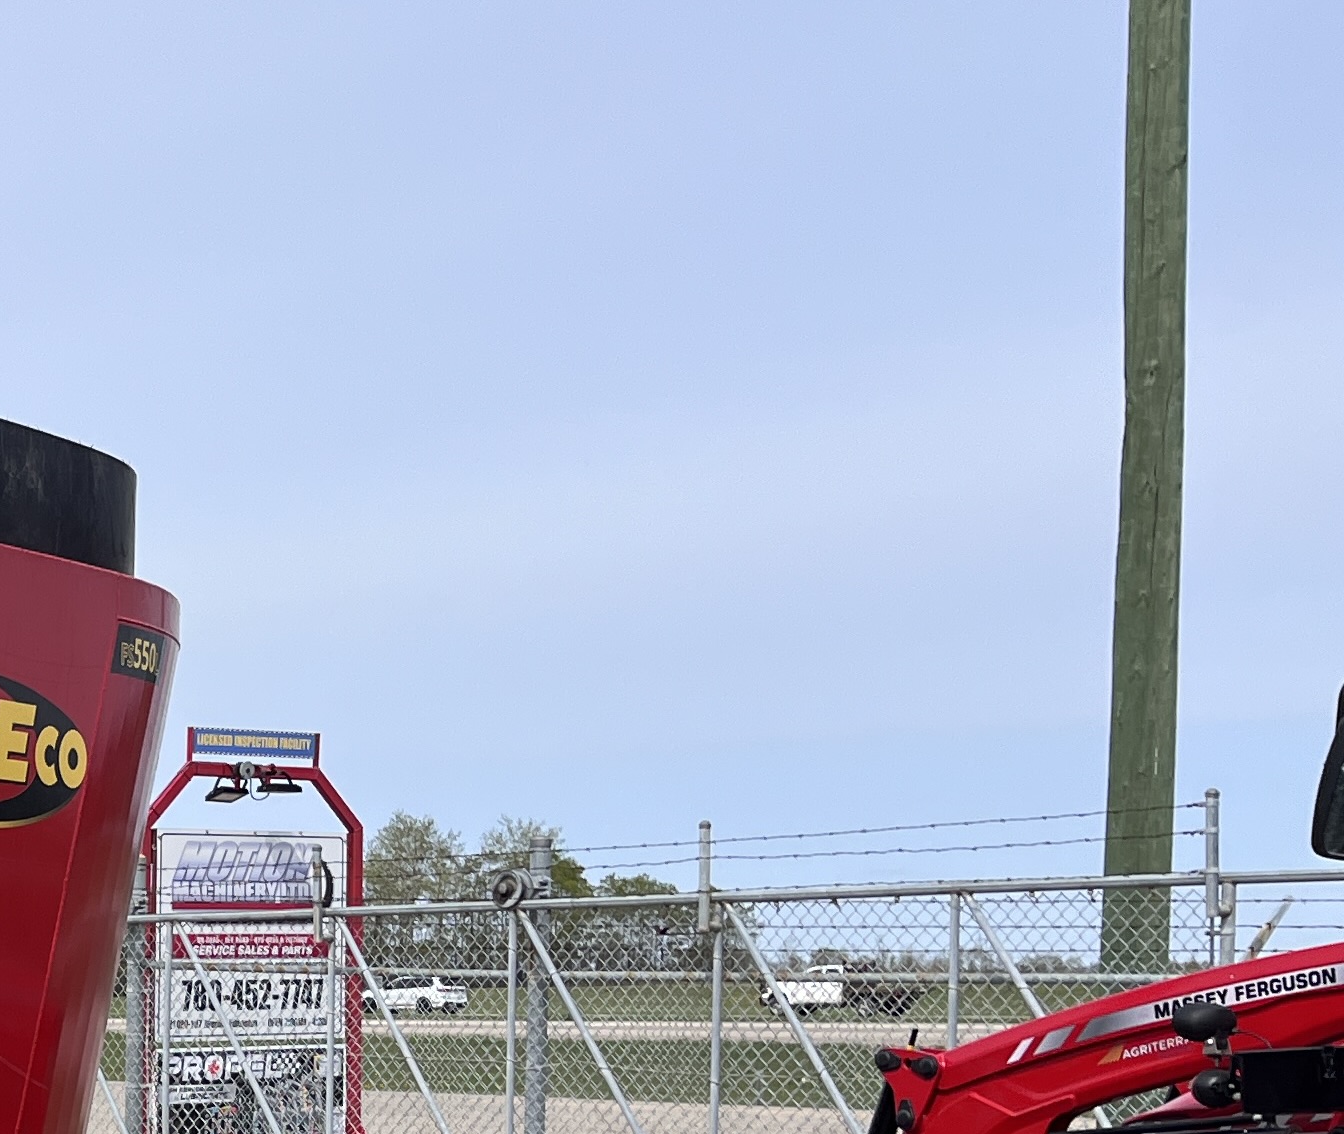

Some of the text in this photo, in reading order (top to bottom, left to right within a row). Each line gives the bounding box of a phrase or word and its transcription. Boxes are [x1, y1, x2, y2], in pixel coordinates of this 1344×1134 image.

[196, 733, 312, 750] LICENSED INSPECTION FACILITY
[173, 840, 314, 882] MOTION
[172, 881, 276, 902] MACHINERY
[193, 944, 235, 956] SERVICE
[237, 944, 270, 956] SALES
[281, 944, 313, 956] PARTS
[1234, 967, 1337, 1002] FERGUSON
[1122, 1036, 1193, 1060] AGRITERR
